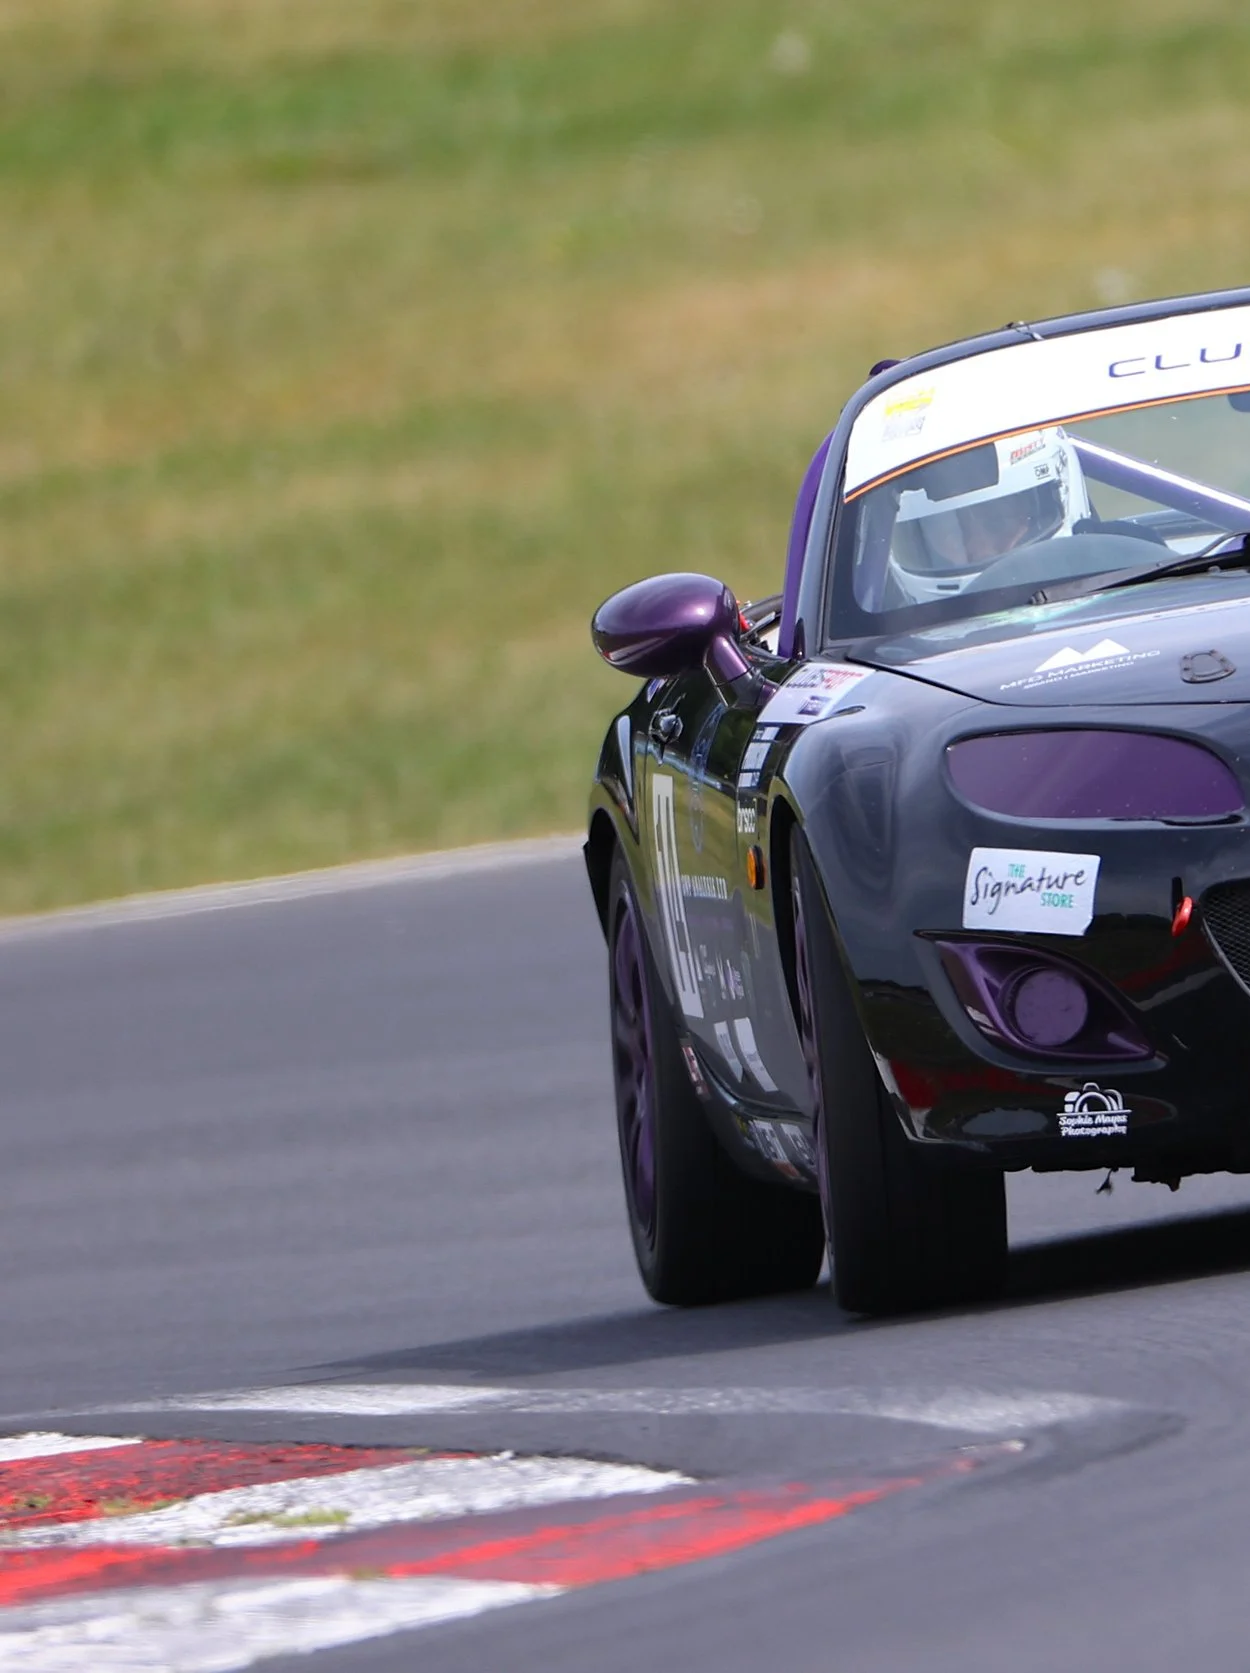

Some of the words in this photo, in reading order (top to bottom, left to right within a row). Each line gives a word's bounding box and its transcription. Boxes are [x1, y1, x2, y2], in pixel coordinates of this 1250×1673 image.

[1047, 649, 1161, 678] MARKETING
[1008, 863, 1025, 878] THE
[970, 866, 1085, 915] Signature
[1040, 892, 1074, 908] STORE
[1059, 1116, 1093, 1127] Sophie
[1060, 1126, 1127, 1137] Photography
